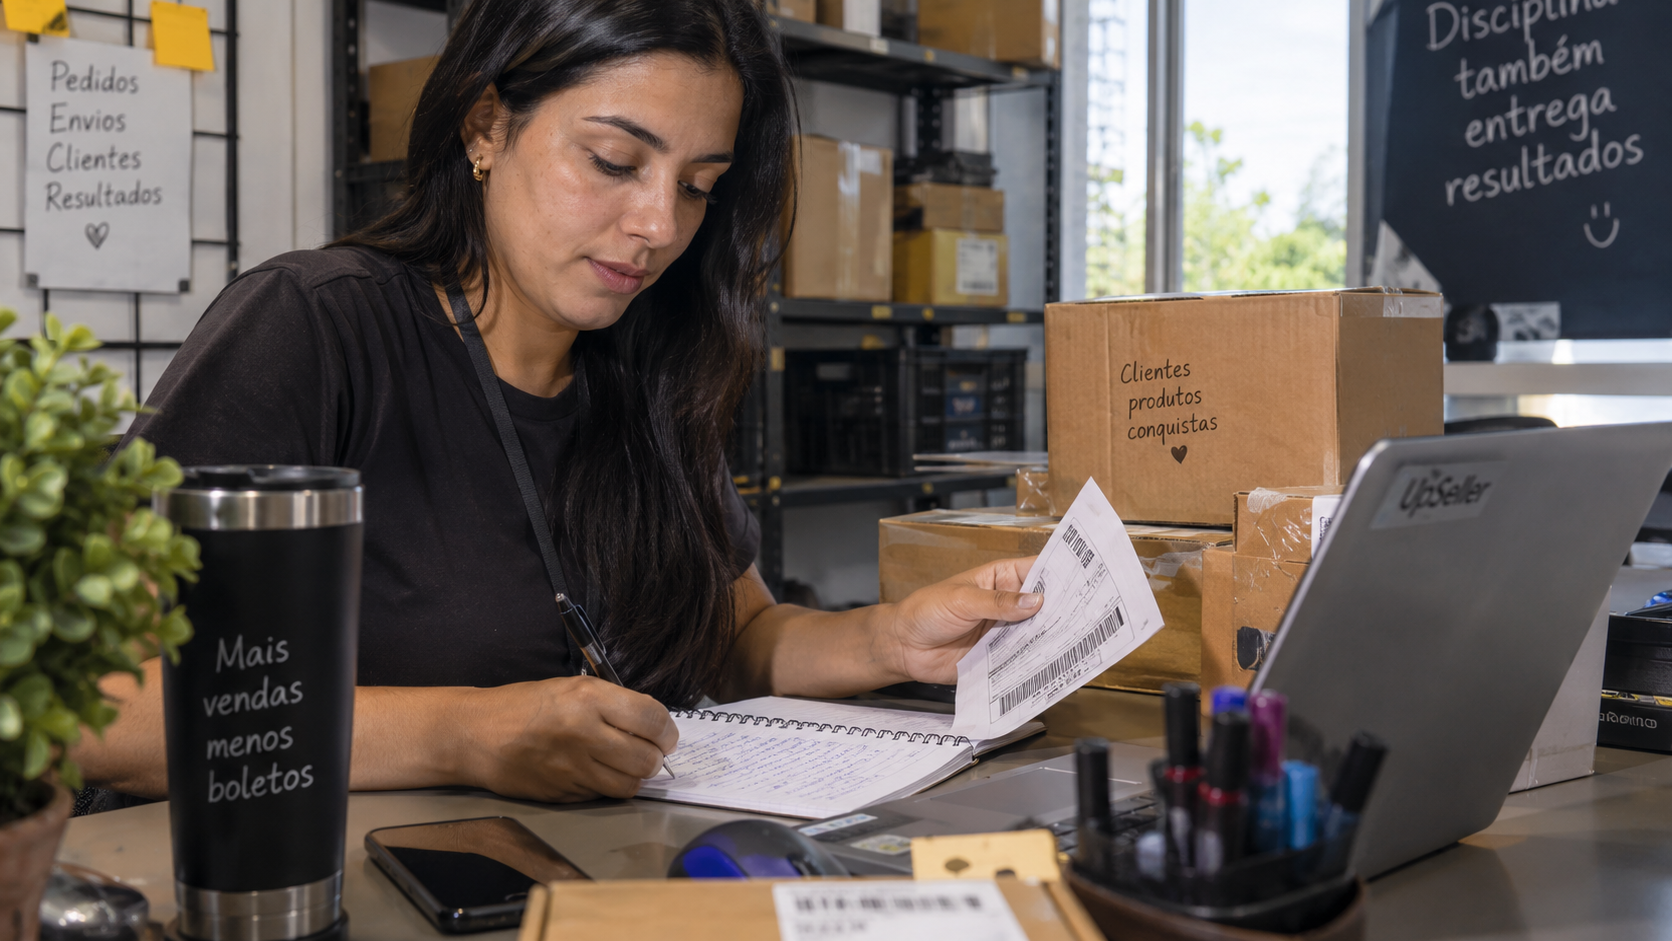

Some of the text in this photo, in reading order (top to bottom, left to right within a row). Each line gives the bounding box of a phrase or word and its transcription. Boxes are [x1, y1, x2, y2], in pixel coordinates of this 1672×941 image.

[51, 60, 139, 94] Pedidos
[1454, 34, 1605, 100] também
[50, 102, 126, 134] Envios
[1465, 87, 1617, 148] entrega
[46, 142, 142, 173] Clientes
[1445, 128, 1644, 207] resultados
[45, 180, 163, 212] Resultados
[1120, 359, 1191, 384] Clientes
[1128, 386, 1202, 420] produtos
[1127, 413, 1218, 446] conquistas
[1400, 474, 1491, 519] UpSeller
[215, 634, 289, 673] Mais
[203, 675, 303, 717] vendas
[207, 726, 294, 760] menos
[208, 762, 314, 803] boletos
